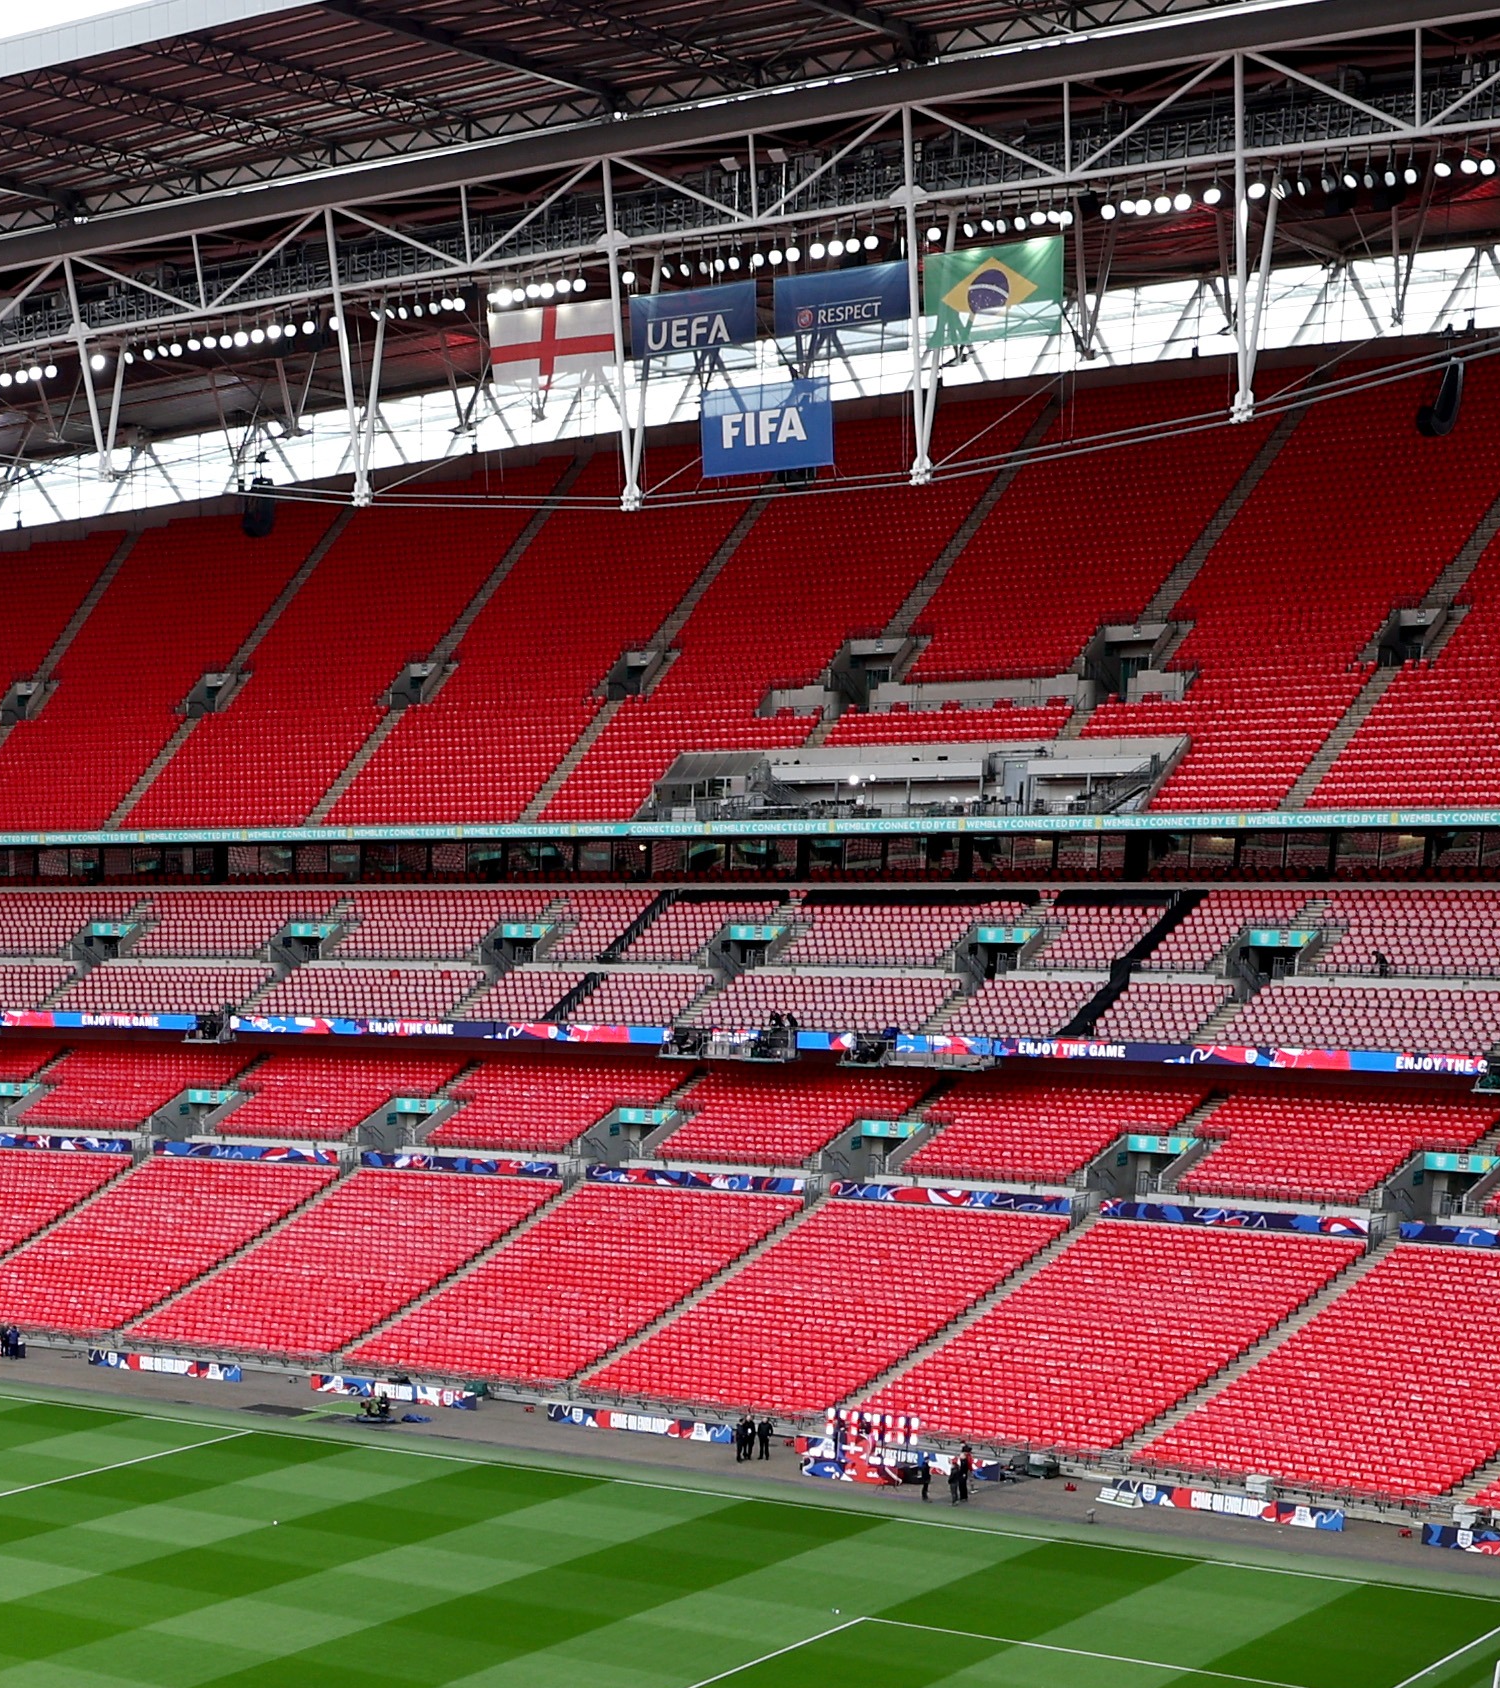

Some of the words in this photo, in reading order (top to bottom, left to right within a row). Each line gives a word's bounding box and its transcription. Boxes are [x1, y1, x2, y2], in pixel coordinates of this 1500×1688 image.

[817, 302, 881, 324] RESPECT
[647, 314, 730, 351] UEFA
[722, 407, 806, 449] FIFA
[1400, 813, 1450, 824] WEMBLEY
[712, 824, 750, 833] WEMBLEY
[752, 823, 804, 833] CONNECTED
[82, 1014, 110, 1025] ENJOY
[110, 1016, 130, 1026] THE
[132, 1016, 159, 1027] GAME
[369, 1022, 401, 1033] ENJOY
[403, 1023, 423, 1034] THE
[424, 1023, 453, 1034] GAME
[1019, 1042, 1058, 1055] ENJOY
[1062, 1044, 1086, 1056] THE
[1089, 1044, 1125, 1057] GAME
[1396, 1056, 1442, 1070] ENJOY
[1446, 1058, 1474, 1072] THE
[1190, 1491, 1212, 1509] COME
[1212, 1494, 1223, 1511] ON
[1224, 1496, 1261, 1516] ENGLAND
